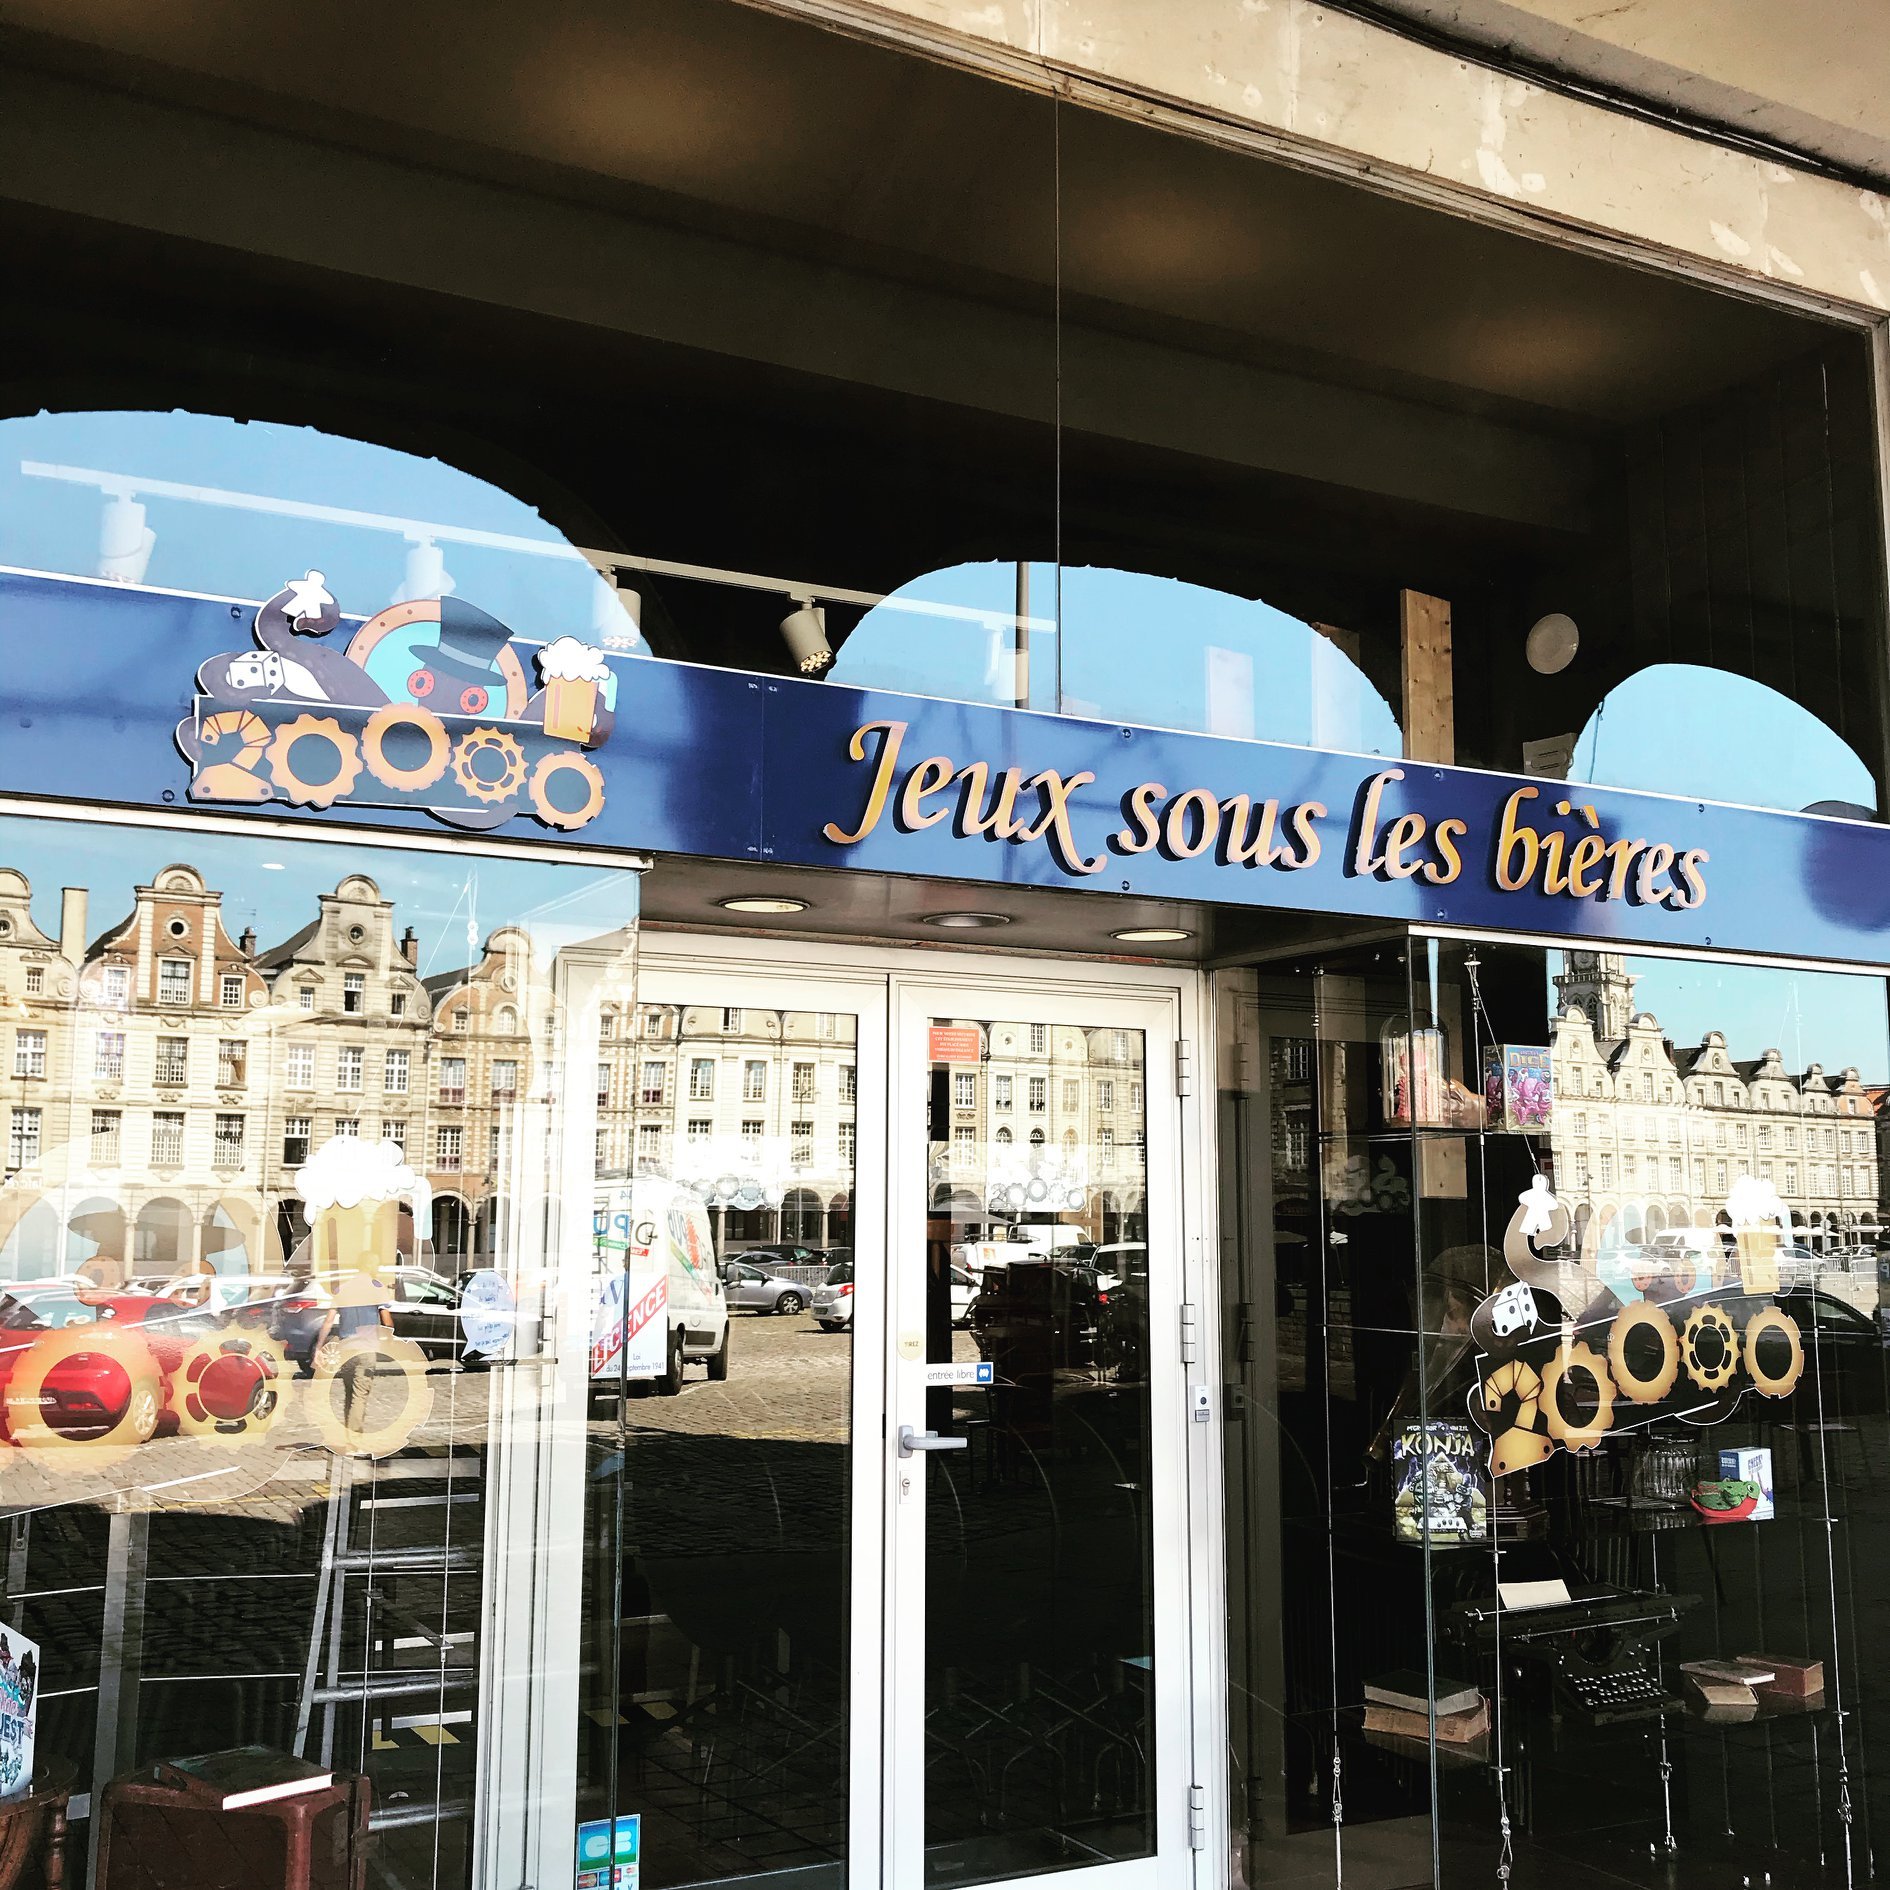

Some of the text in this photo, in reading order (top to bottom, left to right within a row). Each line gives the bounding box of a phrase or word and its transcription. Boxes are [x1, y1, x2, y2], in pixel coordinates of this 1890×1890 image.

[822, 719, 1709, 910] Jeux sous les bières
[632, 1353, 641, 1361] Loi
[613, 1364, 621, 1372] 24
[652, 1362, 665, 1370] 1941
[927, 1369, 975, 1380] entrée libre
[1401, 1432, 1475, 1457] KONJA
